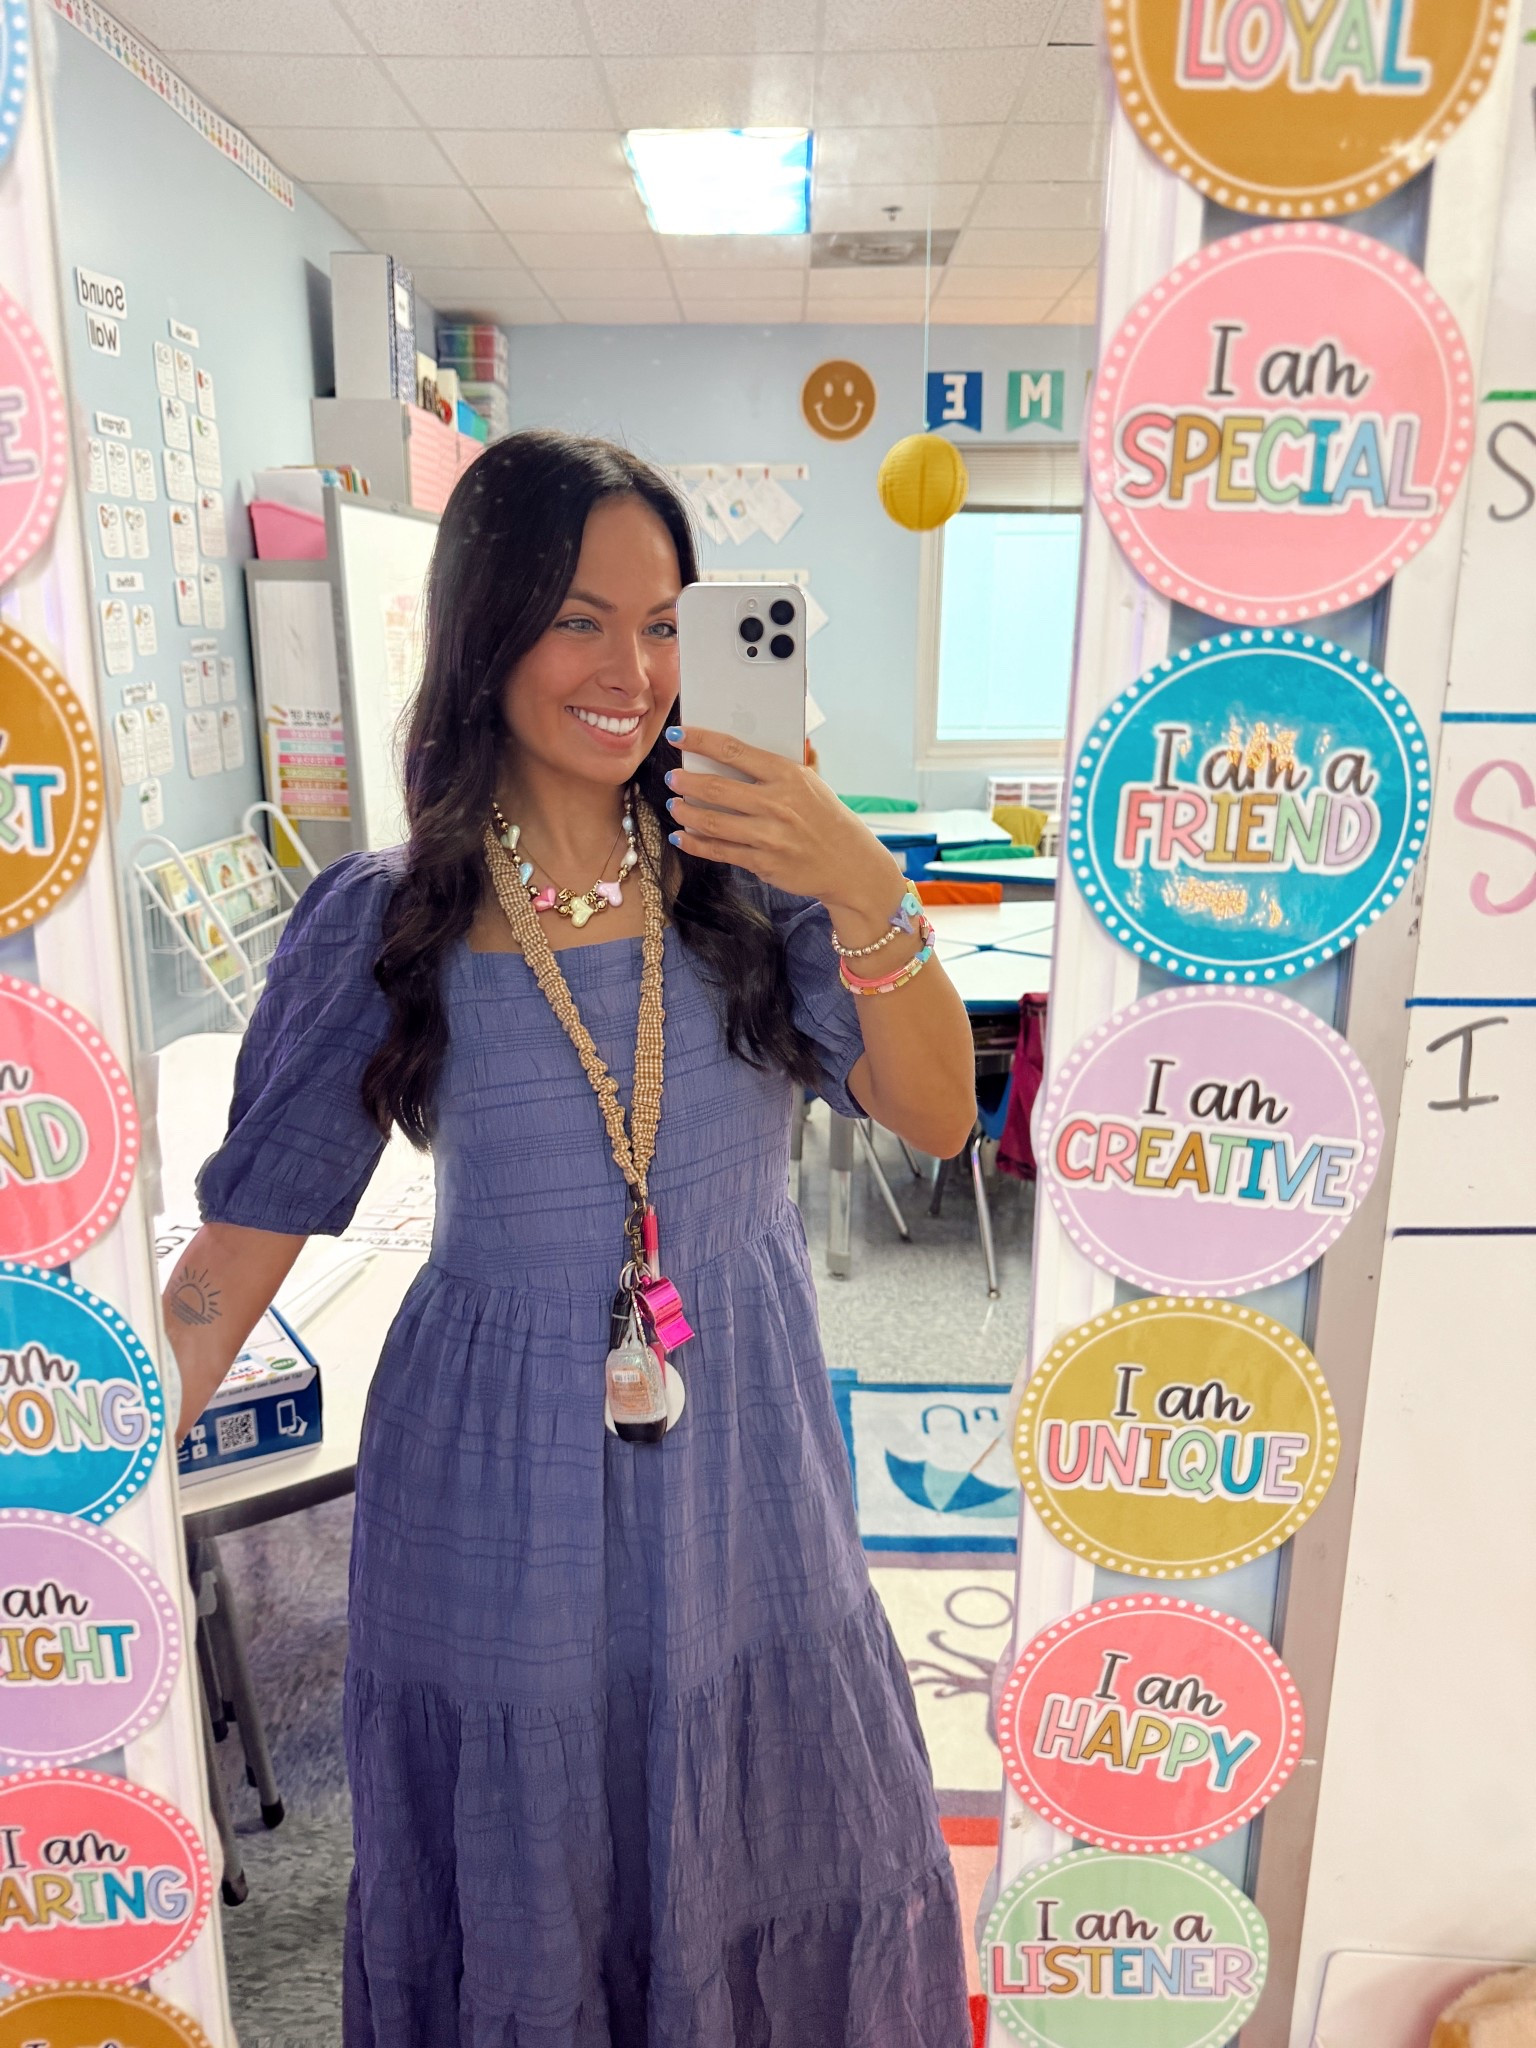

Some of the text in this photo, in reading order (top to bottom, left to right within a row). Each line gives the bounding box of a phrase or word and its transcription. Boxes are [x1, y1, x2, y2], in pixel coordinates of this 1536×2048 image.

[1183, 0, 1422, 84] LOYAL
[1208, 326, 1368, 398] I am
[1122, 413, 1431, 510] SPECIAL
[1154, 728, 1375, 798] I am a
[1121, 789, 1377, 866] FRIEND
[1143, 1059, 1288, 1124] I am
[1055, 1119, 1354, 1207] CREATIVE
[1113, 1366, 1250, 1422] I am
[1047, 1424, 1305, 1498] UNIQUE
[2, 1583, 88, 1619] am
[0, 1625, 133, 1681] IGHT
[1095, 1652, 1223, 1717] I am
[1040, 1698, 1253, 1788] HAPPY
[1, 1829, 126, 1869] I am
[1036, 1901, 1212, 1942] I am a
[992, 1946, 1254, 1995] LISTENER
